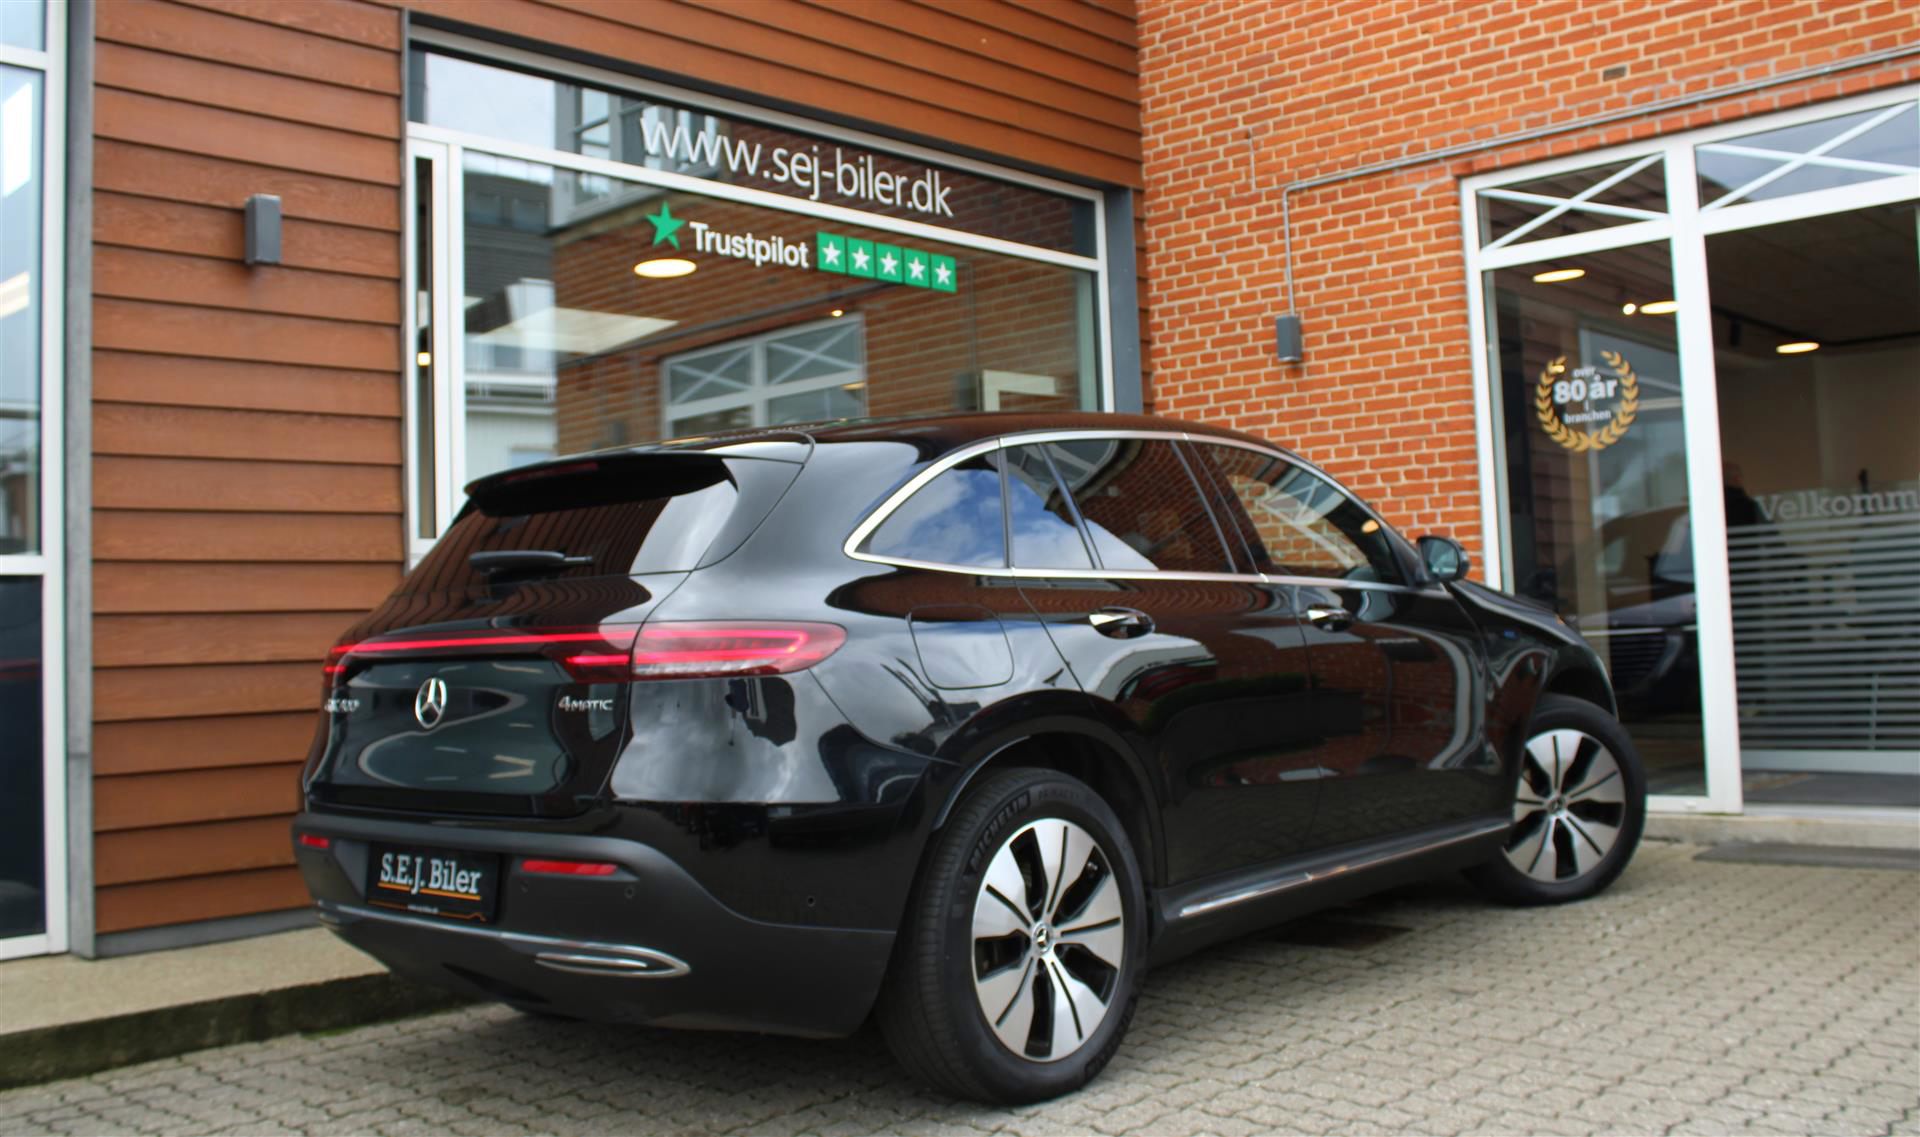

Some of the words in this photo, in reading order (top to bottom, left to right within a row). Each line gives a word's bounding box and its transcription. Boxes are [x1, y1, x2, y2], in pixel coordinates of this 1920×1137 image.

[640, 117, 954, 217] www.sej-biler.dk
[689, 221, 809, 268] Trustpilot
[1554, 379, 1587, 404] 80
[1590, 374, 1618, 399] år
[1564, 410, 1611, 424] branchen
[967, 790, 1032, 873] MICHELIN
[380, 852, 426, 895] S.E.J.
[428, 858, 482, 894] Biler
